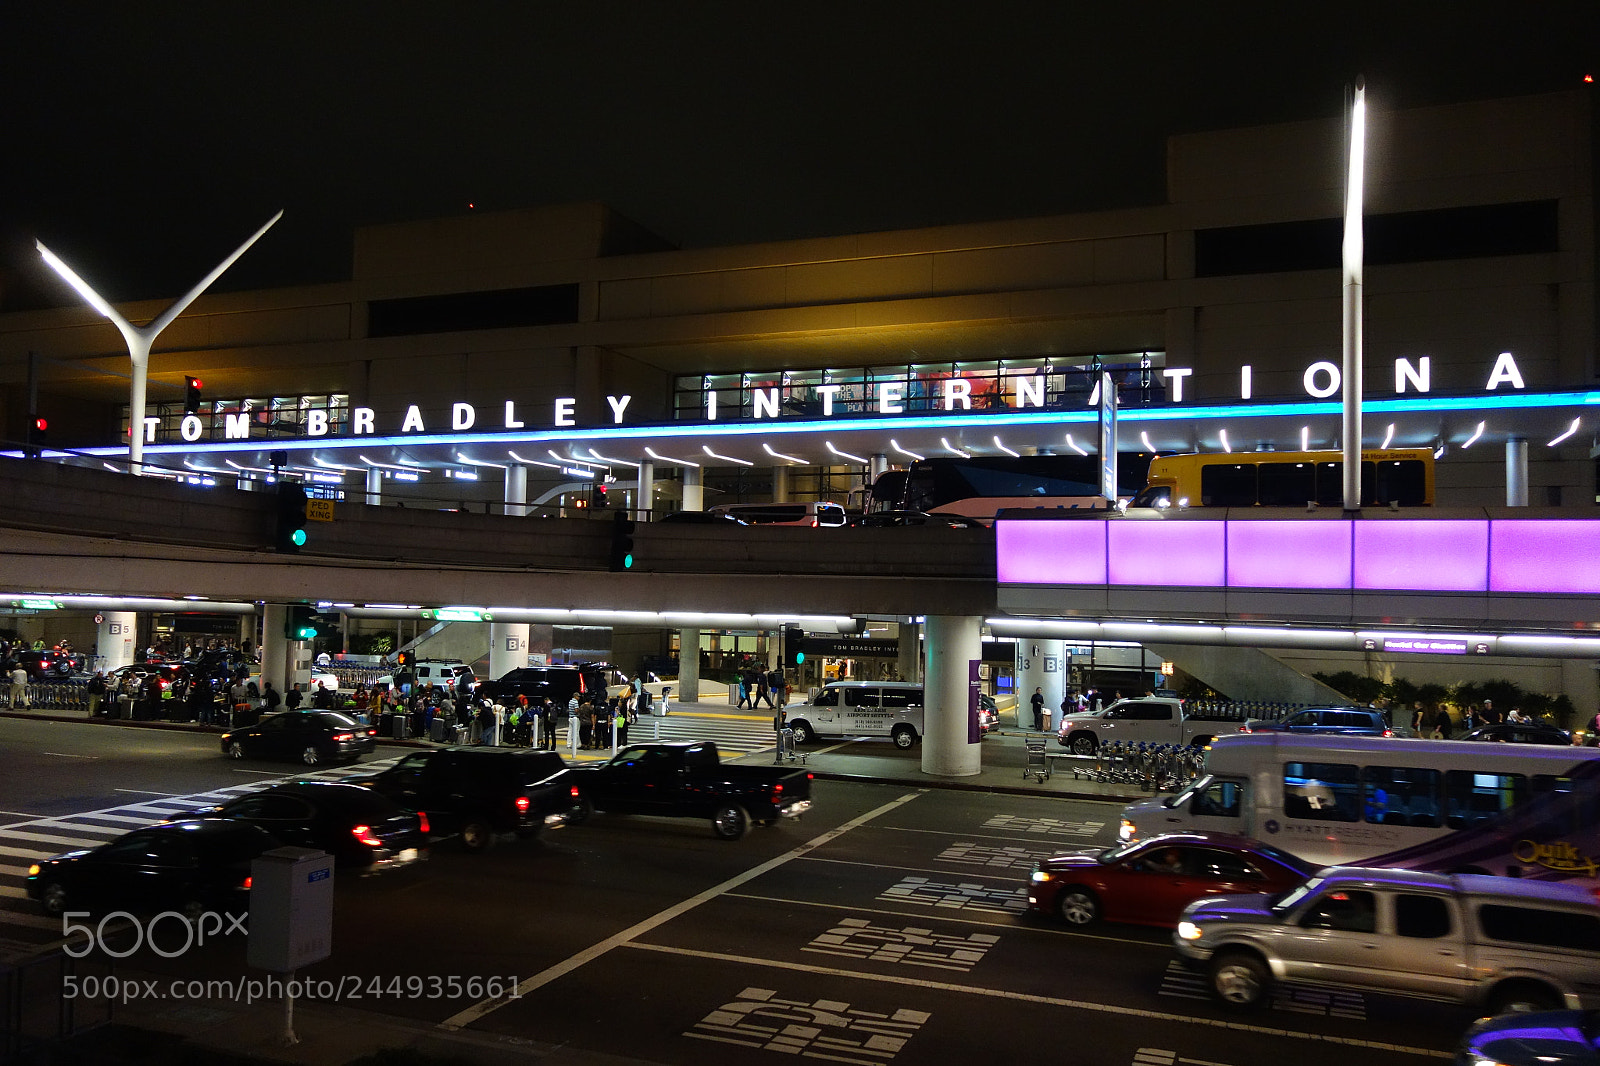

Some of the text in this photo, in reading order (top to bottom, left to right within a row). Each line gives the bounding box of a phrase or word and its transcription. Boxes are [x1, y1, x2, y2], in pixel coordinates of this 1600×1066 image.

[835, 391, 852, 399] THE
[143, 413, 250, 442] TOM
[308, 395, 632, 437] BRADLEY
[311, 501, 329, 510] PED
[310, 510, 330, 520] XING
[1023, 659, 1031, 670] 3
